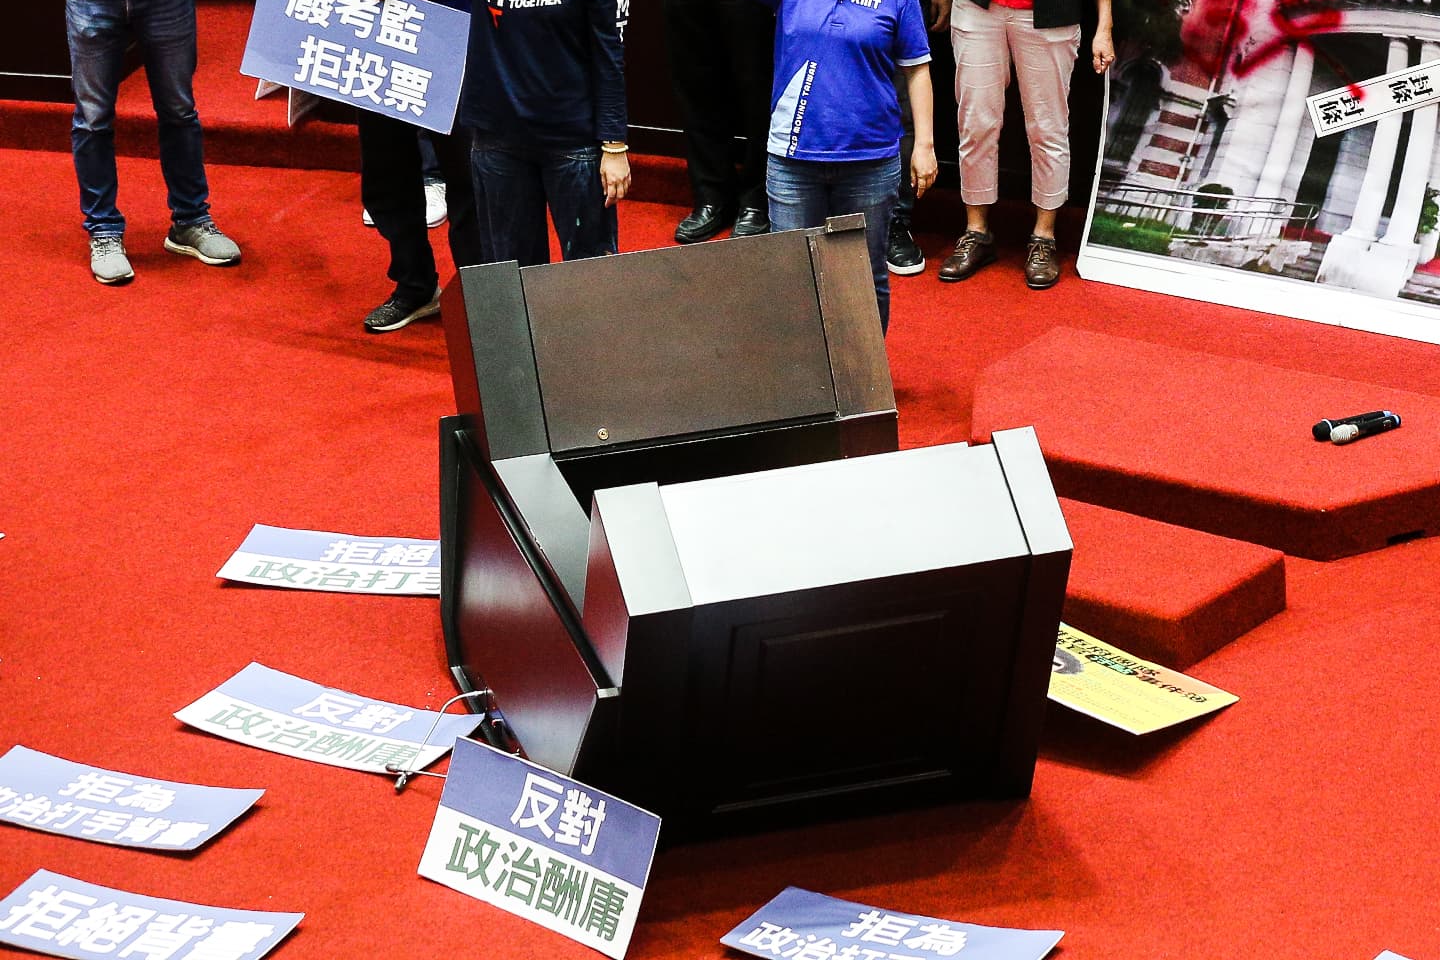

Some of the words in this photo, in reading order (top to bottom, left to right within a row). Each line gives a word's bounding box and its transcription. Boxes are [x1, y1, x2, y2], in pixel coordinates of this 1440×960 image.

[294, 34, 433, 118] 拒投票
[794, 99, 807, 134] MOVING
[802, 61, 818, 96] TAIWAN
[320, 540, 438, 567] 拒絕
[205, 703, 426, 769] 政治酬庸
[292, 692, 415, 734] 反對
[58, 772, 177, 813] 拒為
[510, 772, 607, 856] 反對
[445, 822, 629, 941] 政治酬庸
[840, 910, 968, 955] 拒為
